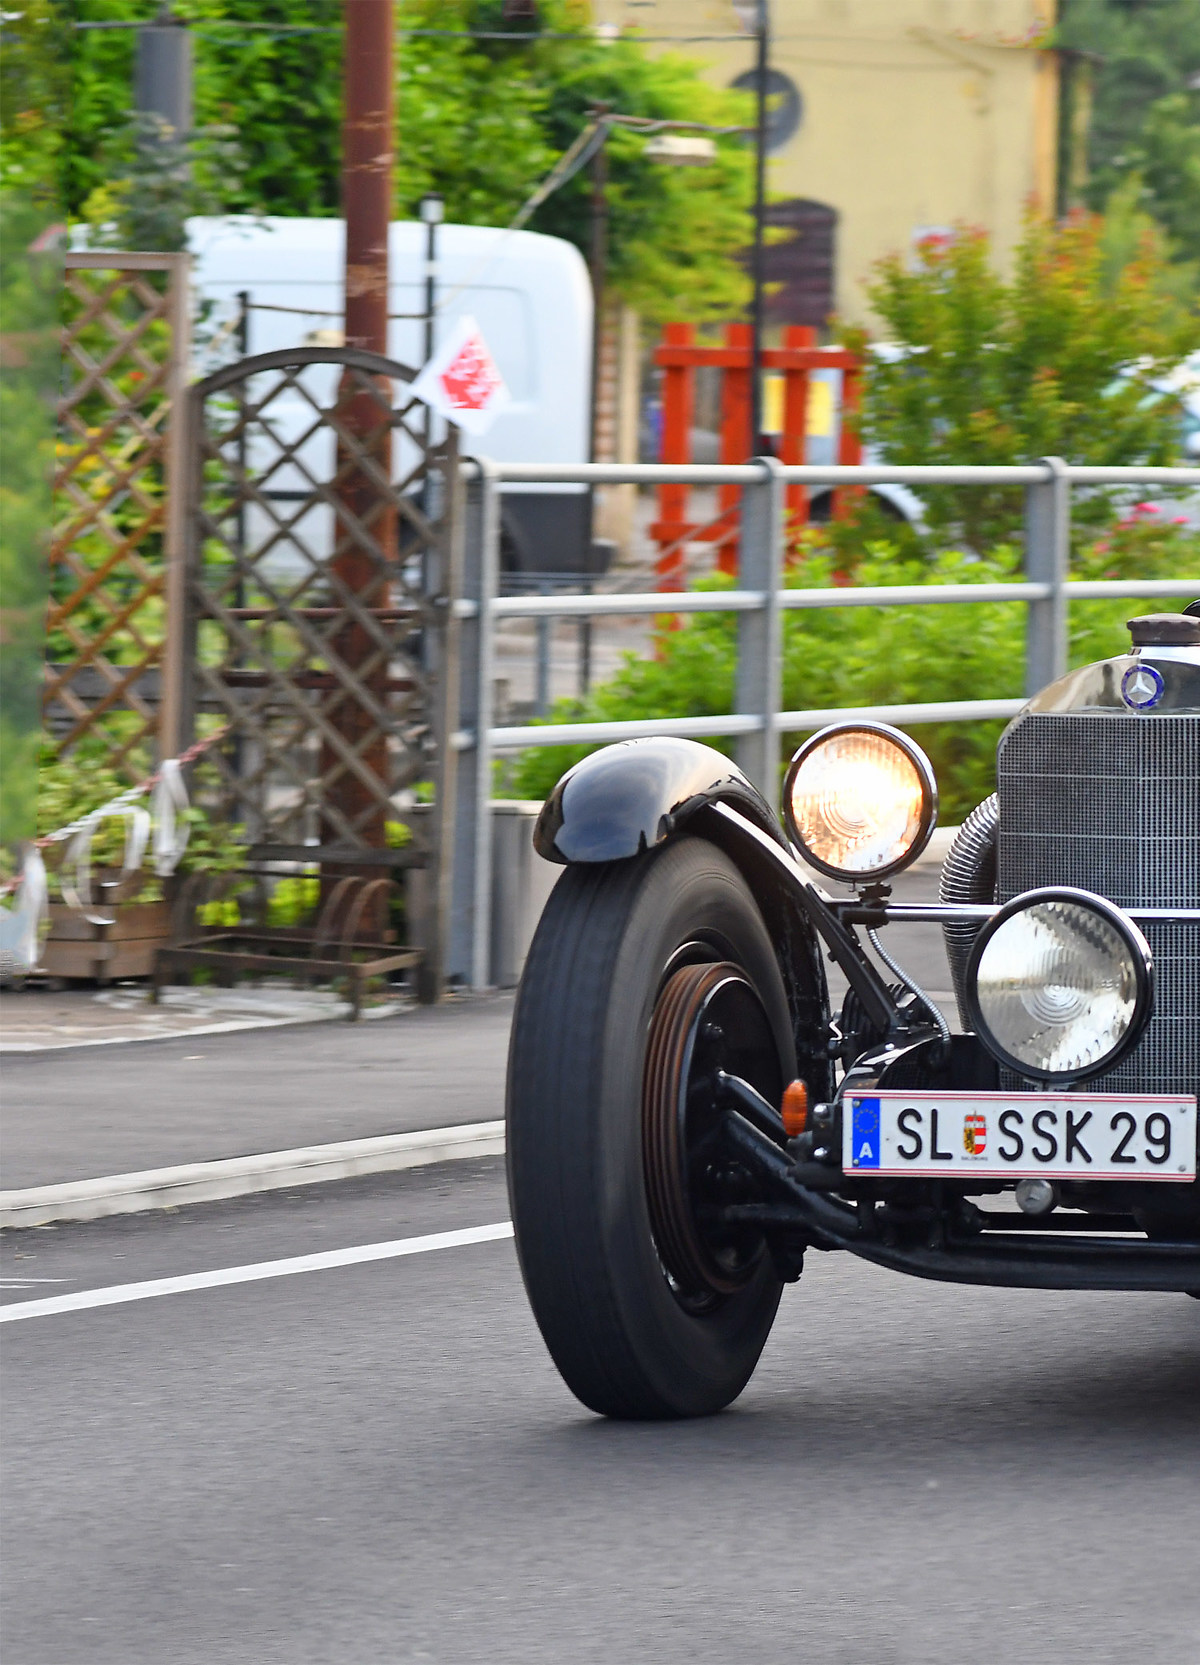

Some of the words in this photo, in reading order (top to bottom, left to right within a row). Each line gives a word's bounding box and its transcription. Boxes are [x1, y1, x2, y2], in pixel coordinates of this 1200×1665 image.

[858, 1142, 873, 1159] A
[897, 1108, 953, 1161] SL
[998, 1109, 1093, 1165] SSK
[1109, 1111, 1171, 1165] 29
